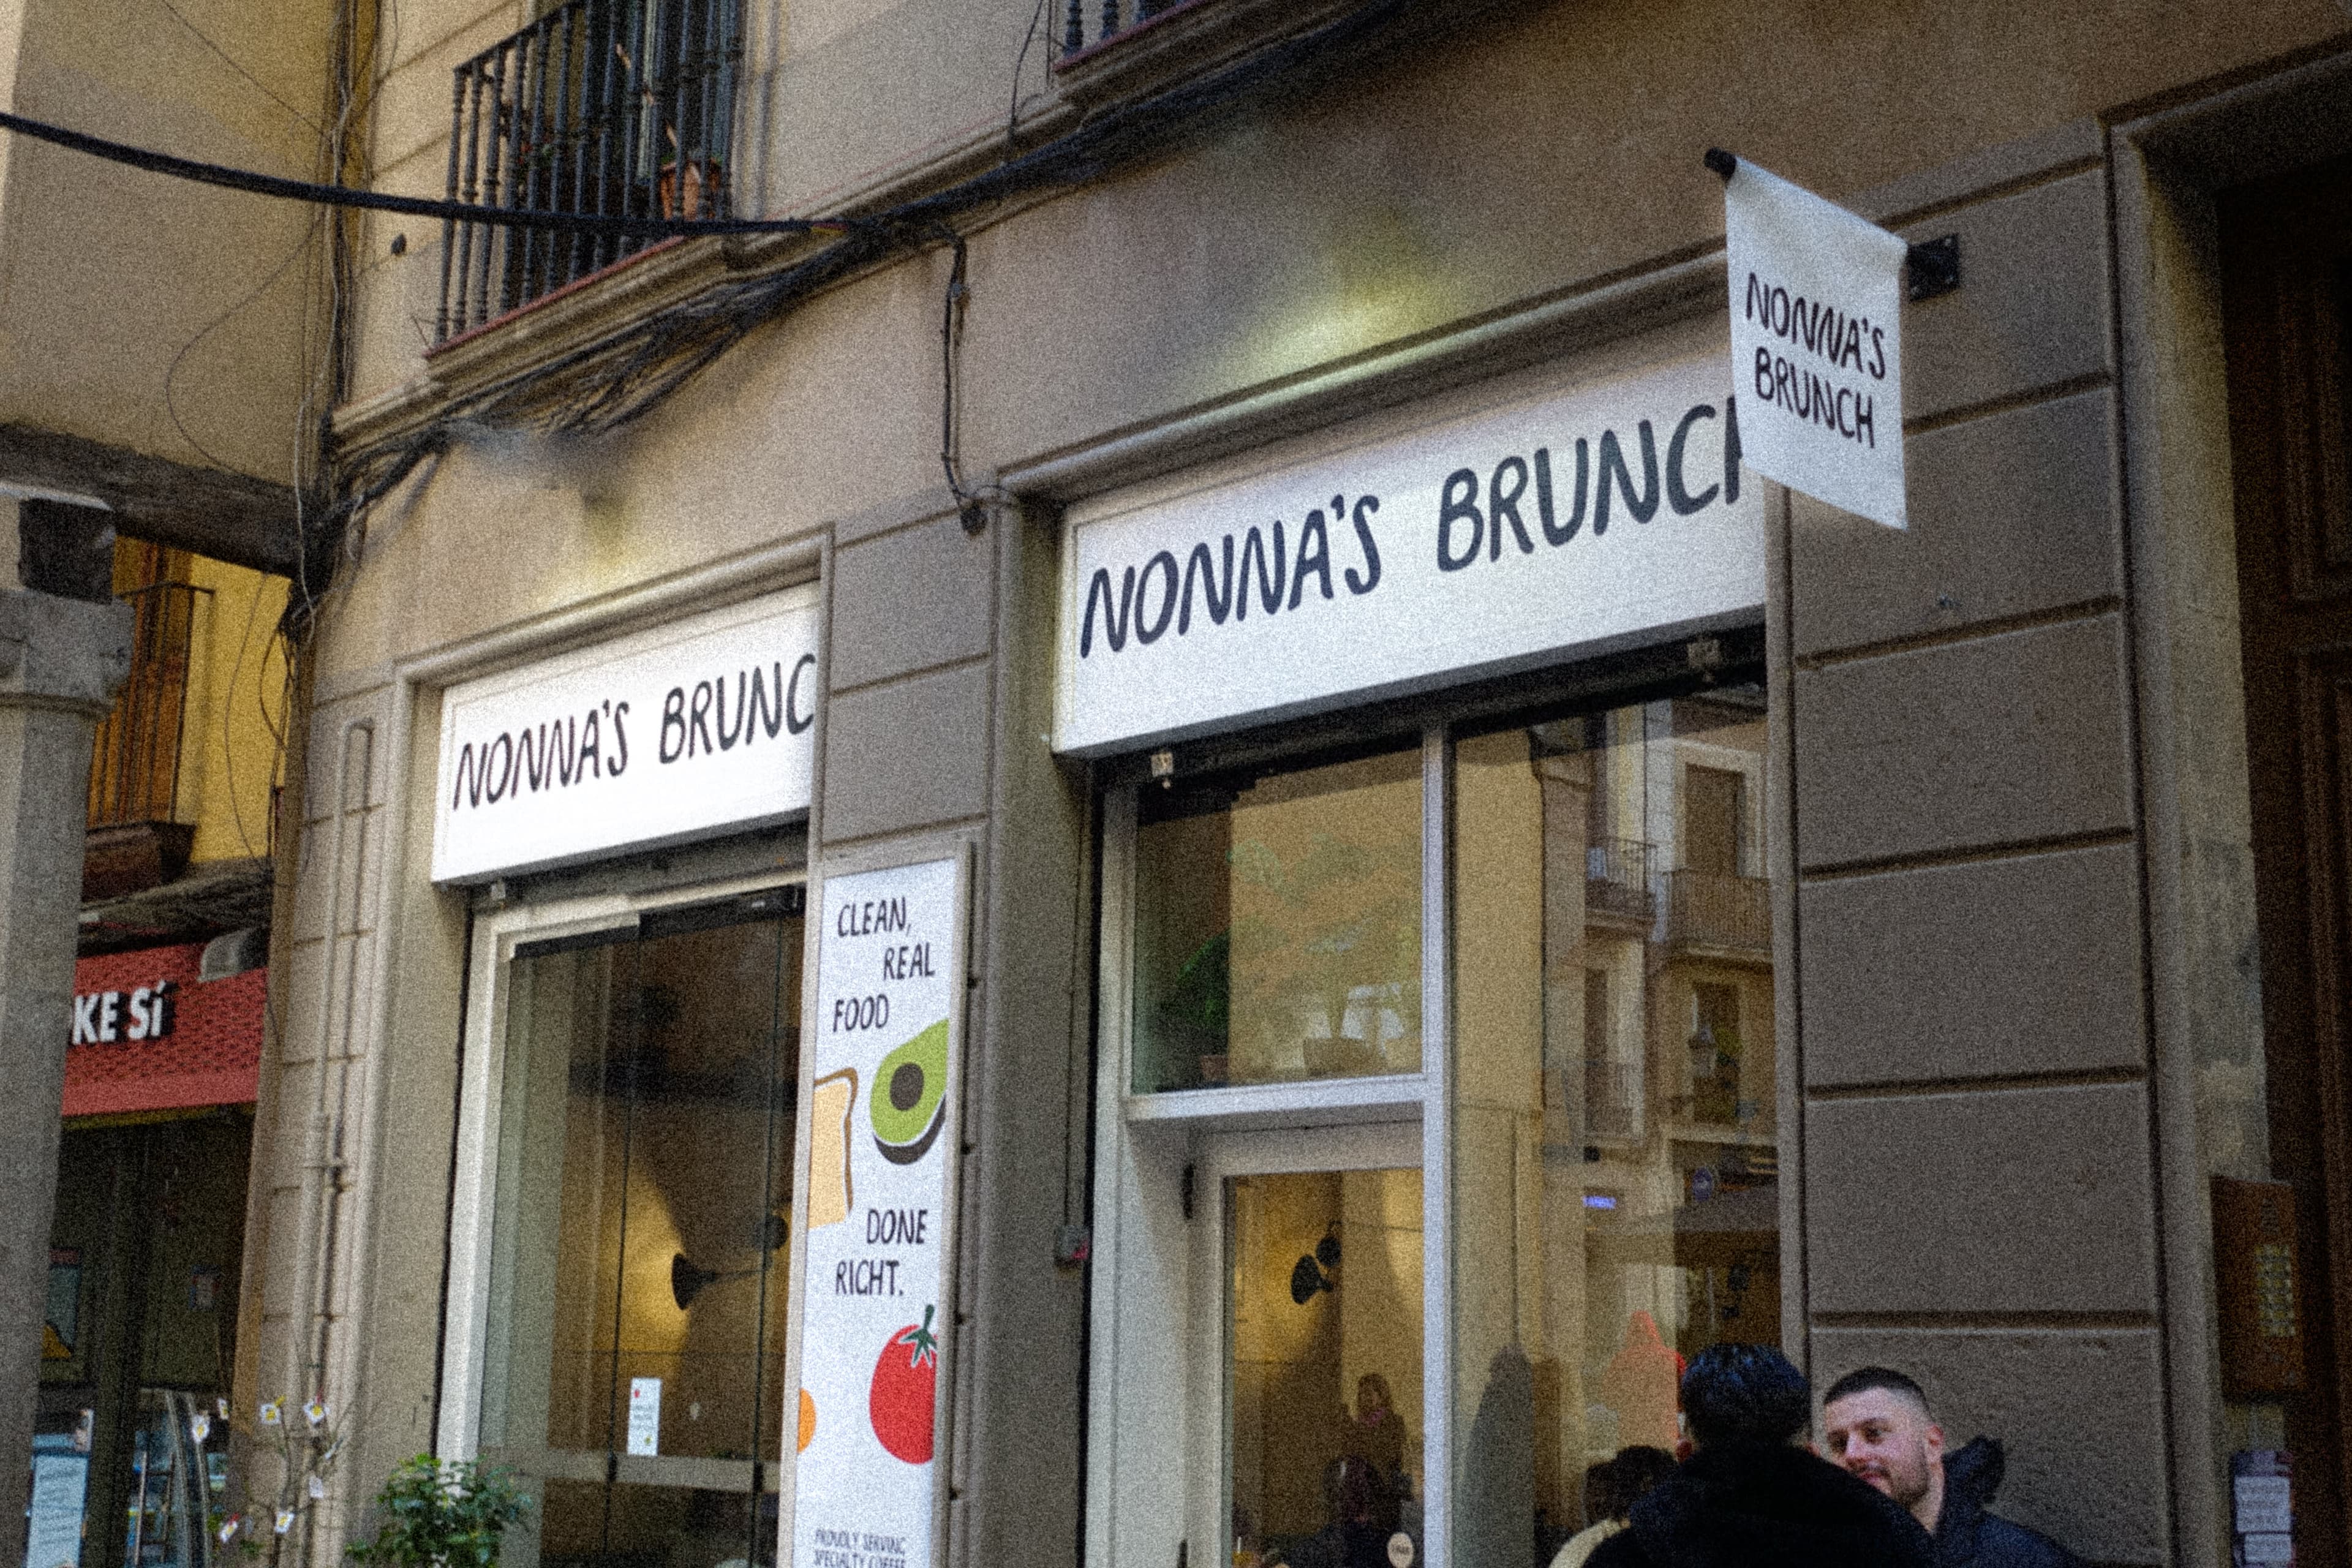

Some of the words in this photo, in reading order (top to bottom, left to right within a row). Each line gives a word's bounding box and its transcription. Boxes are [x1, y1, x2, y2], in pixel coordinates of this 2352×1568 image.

[1746, 273, 1886, 380] NONNA'S
[1755, 346, 1875, 448] BRUNCH
[1080, 495, 1381, 658] NONNA'S
[454, 699, 629, 809] NONNA'S
[660, 654, 816, 764] BRUNC
[837, 897, 911, 938] CLEAN,
[884, 943, 935, 980] REAL
[833, 994, 889, 1032] FOOD
[867, 1208, 928, 1244] DONE
[835, 1260, 903, 1296] RIGHT.
